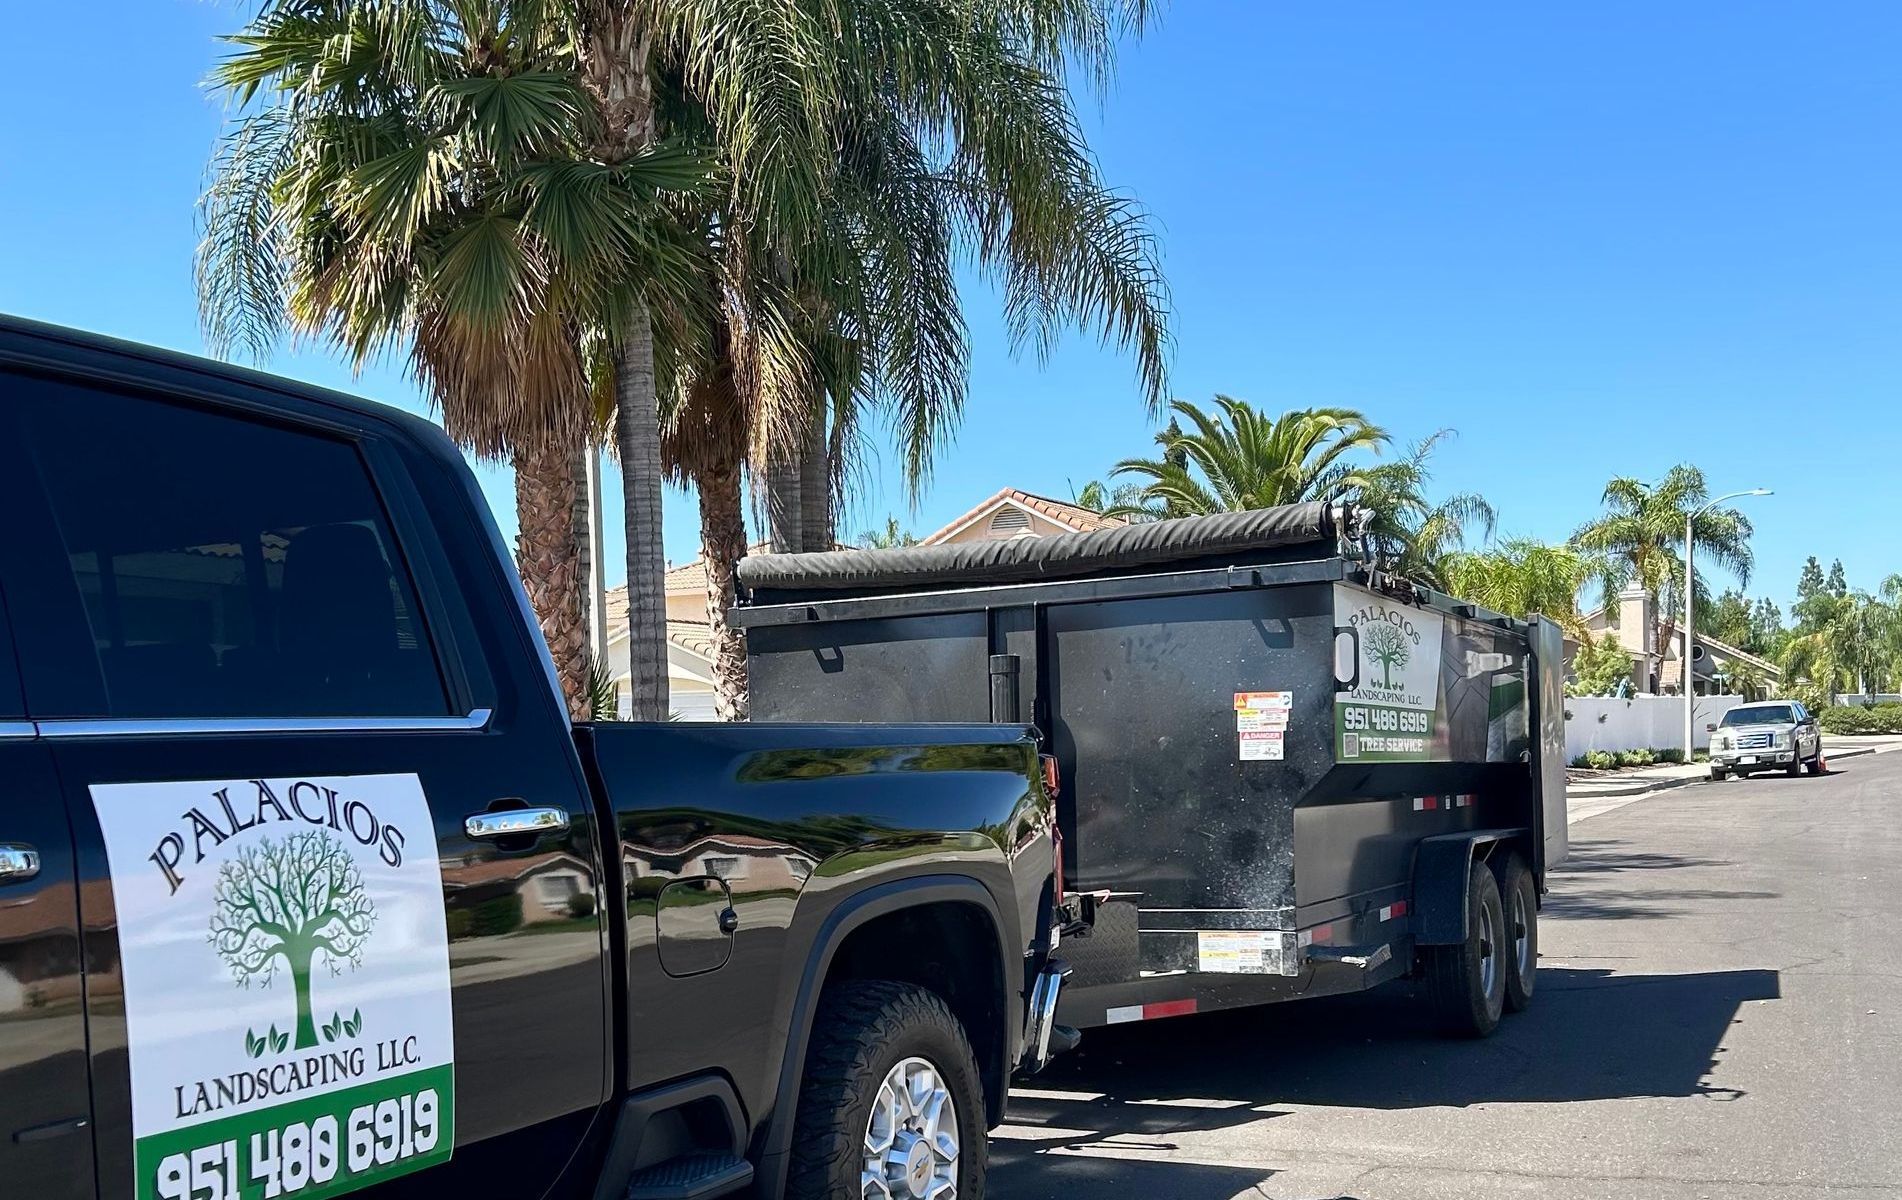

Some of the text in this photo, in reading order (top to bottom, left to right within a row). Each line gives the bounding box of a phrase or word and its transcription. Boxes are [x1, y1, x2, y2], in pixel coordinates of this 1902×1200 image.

[1348, 605, 1421, 645] PALACIOS
[1351, 688, 1405, 704] LANDSCAPING
[1250, 732, 1280, 740] DANGER
[1344, 707, 1428, 733] 951 480 6919
[1360, 737, 1423, 752] TREE SERVICE
[148, 779, 405, 896] PALACIOS
[174, 1036, 422, 1119] LANDSCAPING LLC.
[156, 1088, 439, 1200] 951 480 6919
